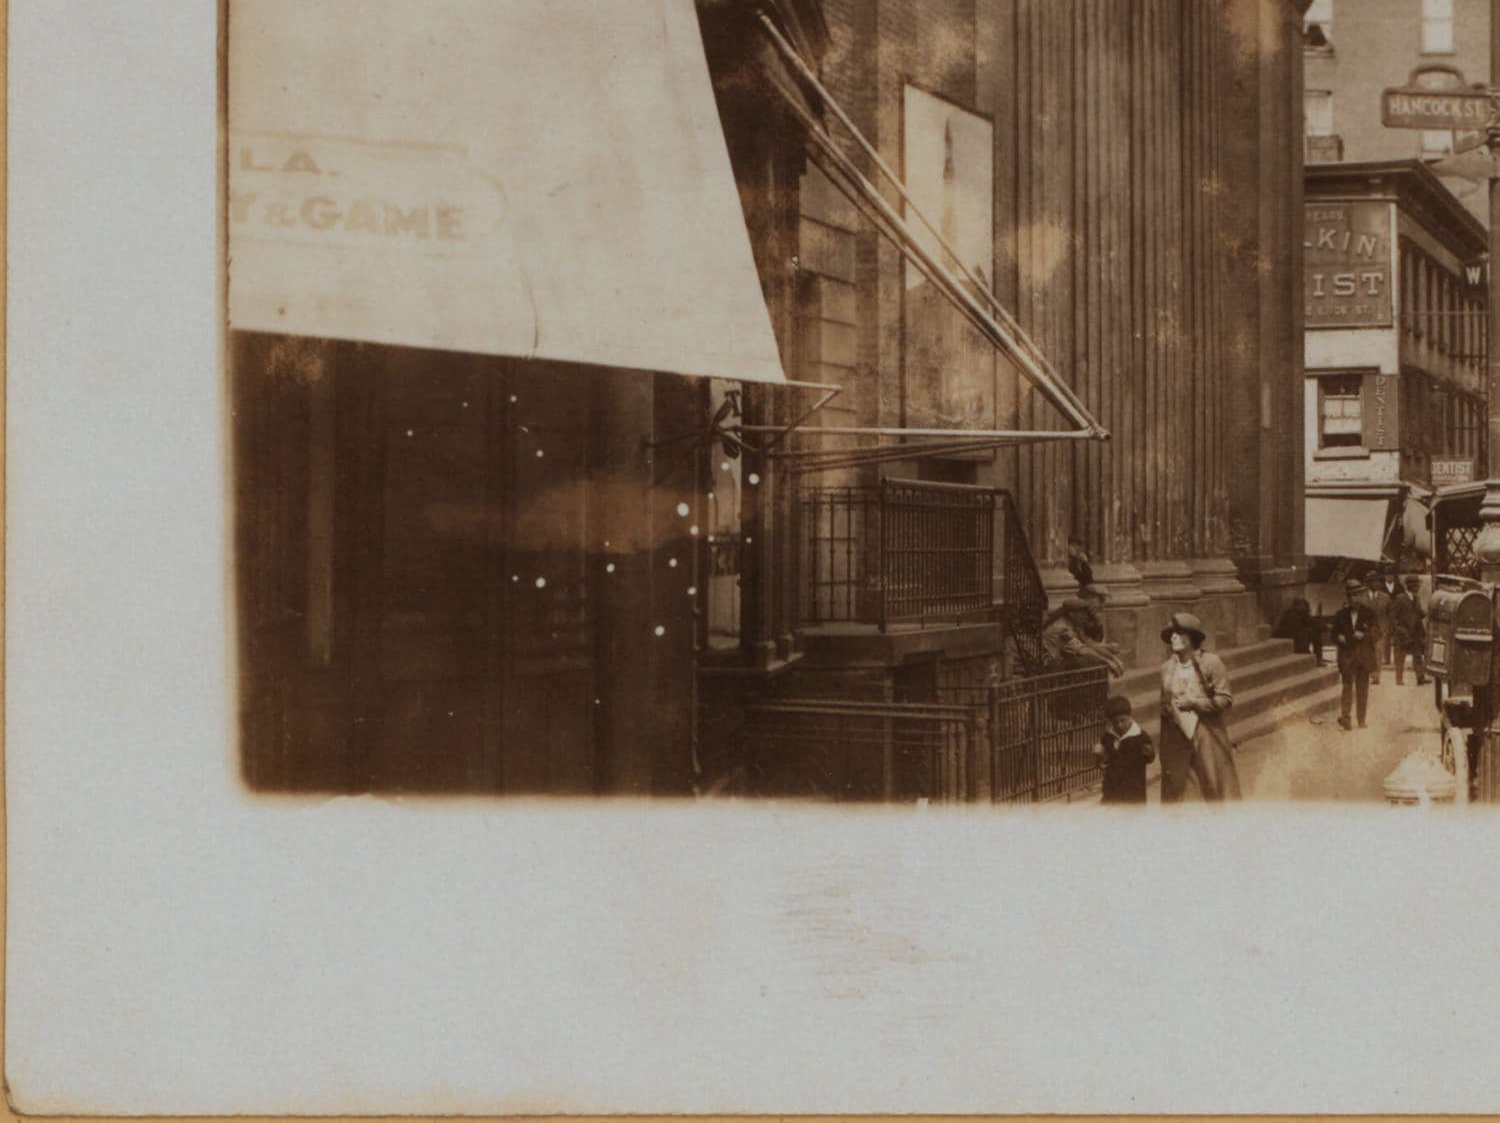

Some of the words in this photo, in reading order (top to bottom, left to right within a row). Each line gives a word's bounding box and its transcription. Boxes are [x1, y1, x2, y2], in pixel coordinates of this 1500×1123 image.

[1389, 95, 1462, 117] HANCOCK
[299, 196, 467, 241] GAME
[1303, 227, 1377, 257] KIN
[1375, 375, 1387, 446] DENTIST
